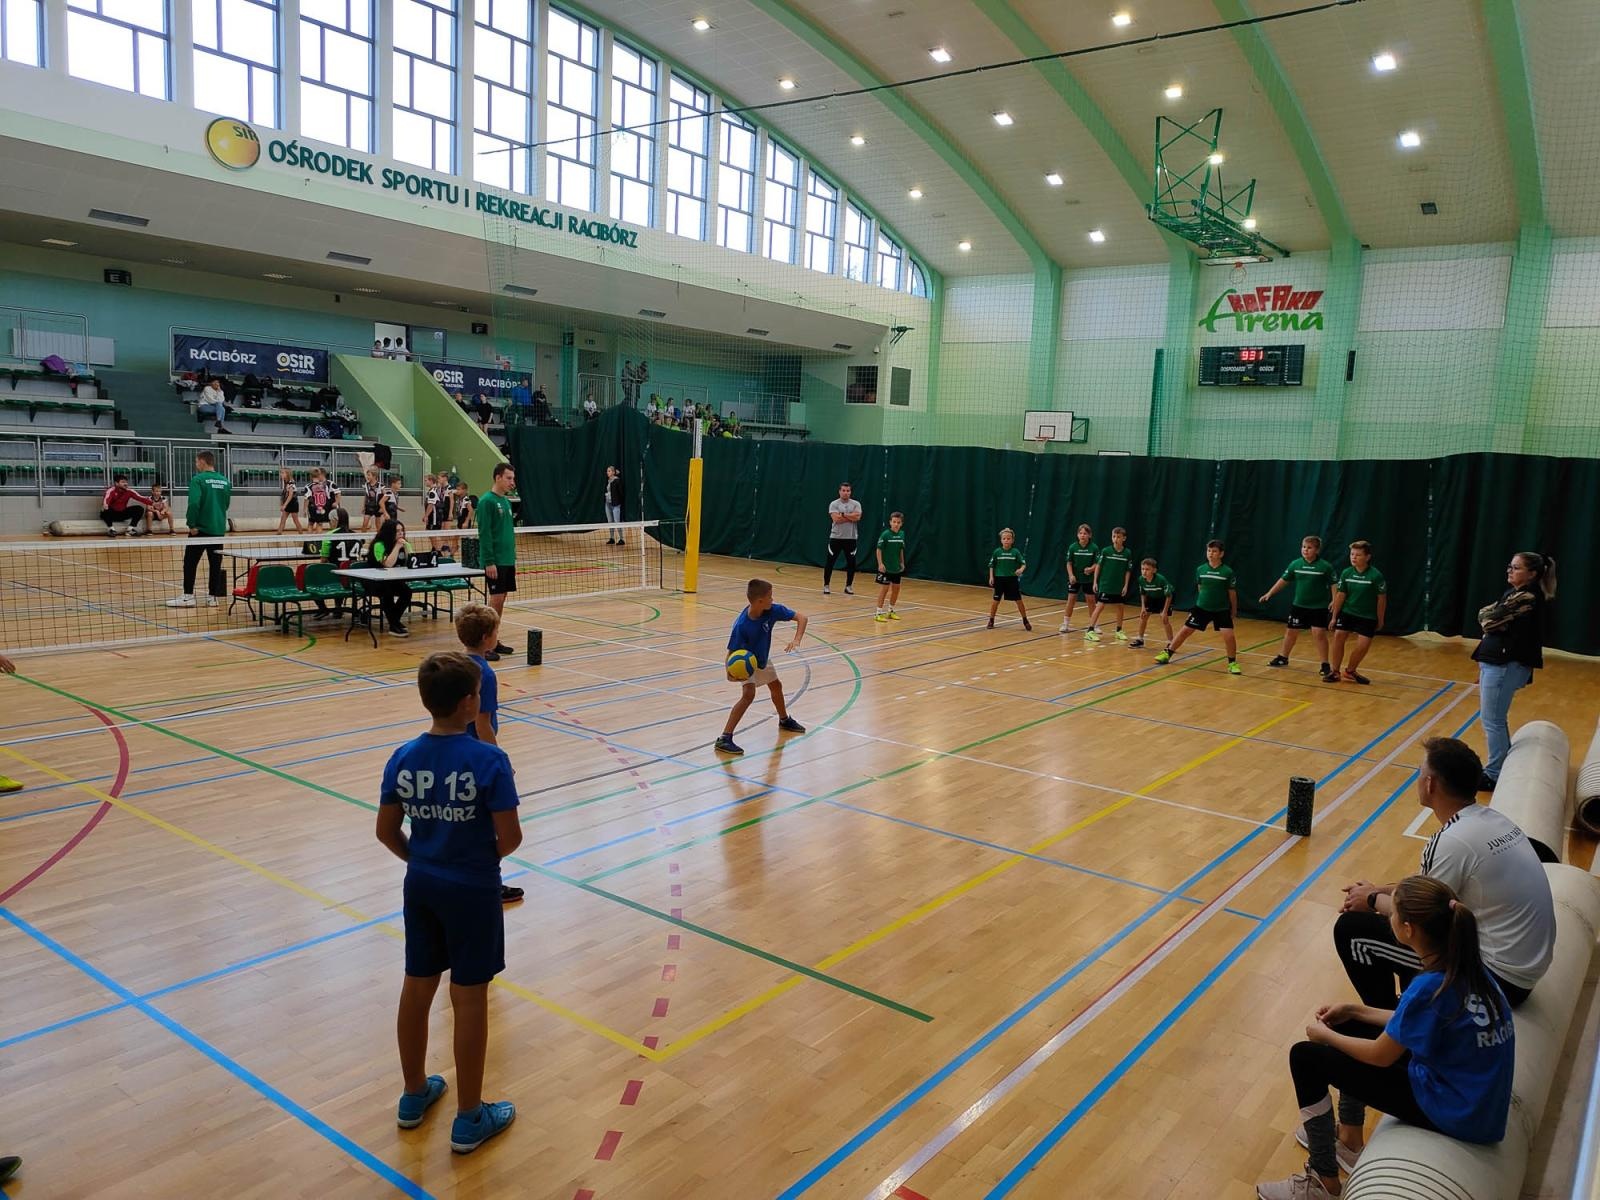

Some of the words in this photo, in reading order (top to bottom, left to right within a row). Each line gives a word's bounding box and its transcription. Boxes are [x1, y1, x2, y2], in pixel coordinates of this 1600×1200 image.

[268, 140, 373, 184] OŚRODEK
[382, 168, 459, 204] SPORTU
[464, 189, 470, 208] I
[476, 192, 563, 231] REKREACJI
[568, 216, 638, 249] RACIBÓRZ
[1198, 288, 1324, 333] Arena
[189, 349, 257, 365] RACIBÓRZ
[335, 541, 361, 562] 14
[430, 555, 437, 567] 4
[410, 556, 419, 569] 2
[395, 769, 435, 800] SP
[444, 771, 478, 802] 13
[401, 802, 476, 822] RACIBÓRZ
